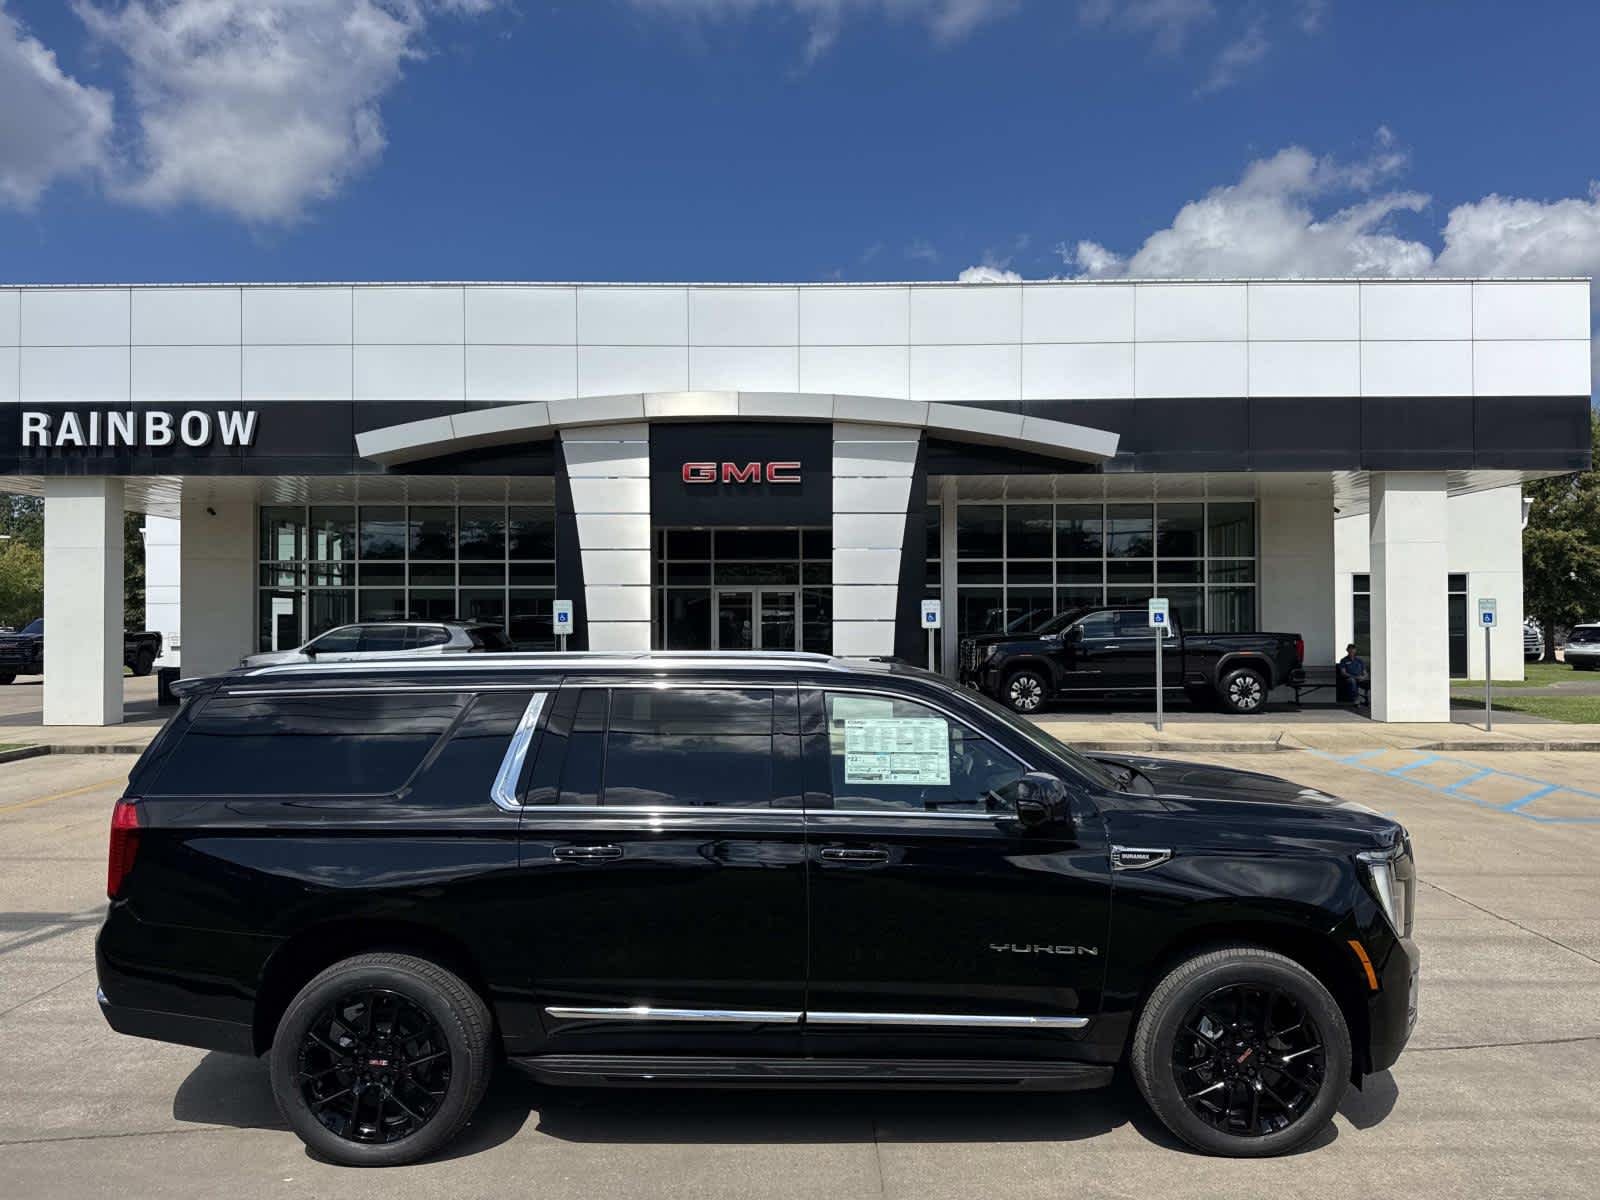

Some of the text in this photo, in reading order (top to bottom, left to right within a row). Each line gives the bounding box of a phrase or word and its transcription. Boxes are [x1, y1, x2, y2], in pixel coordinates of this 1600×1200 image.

[22, 410, 257, 447] RAINBOW
[682, 462, 801, 483] GMC
[989, 943, 1098, 956] YUKON
